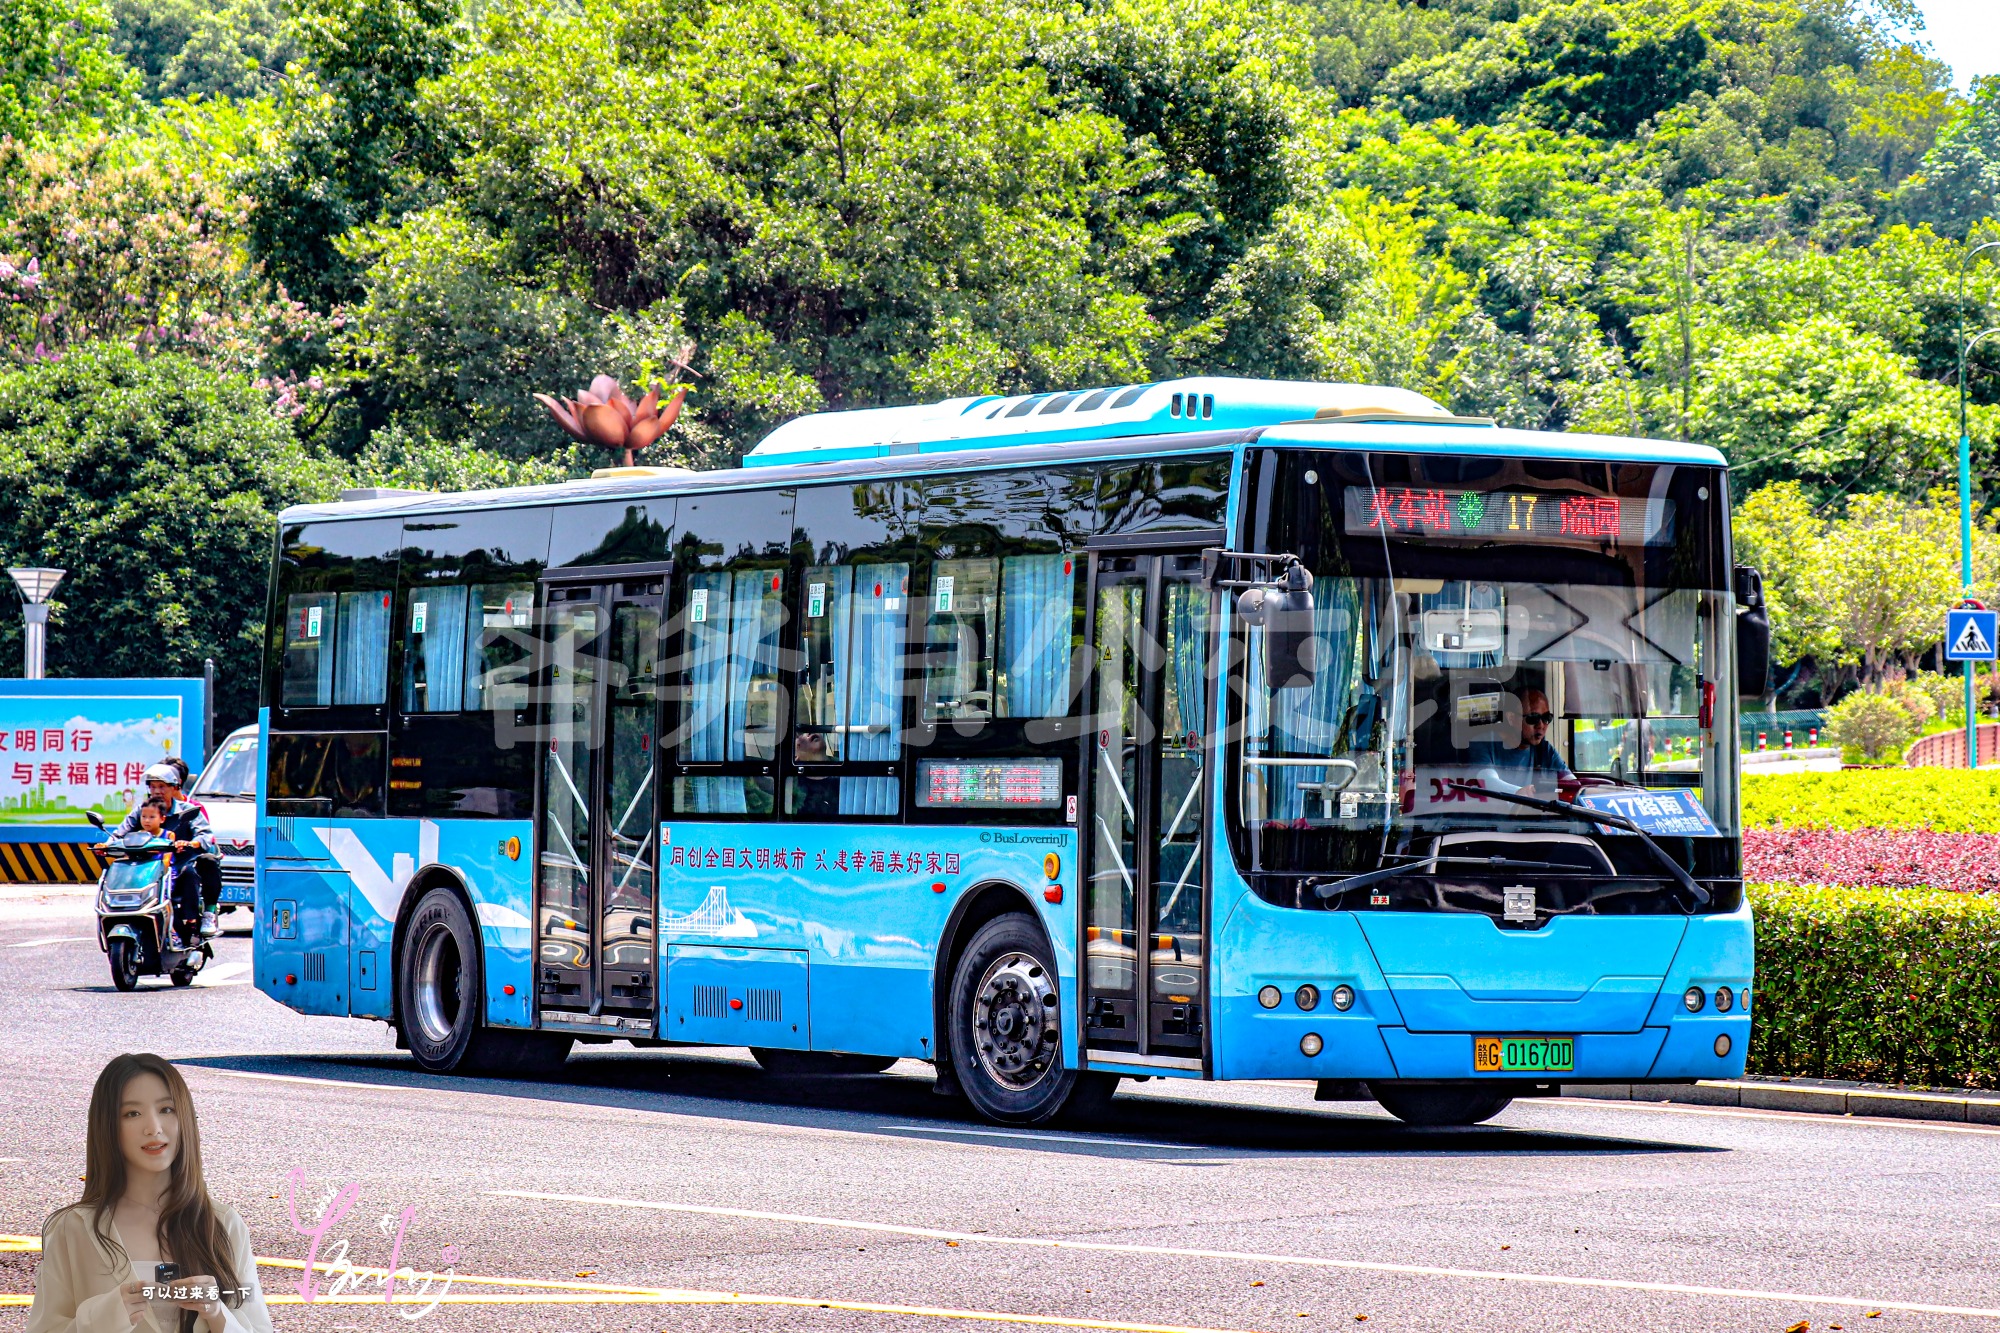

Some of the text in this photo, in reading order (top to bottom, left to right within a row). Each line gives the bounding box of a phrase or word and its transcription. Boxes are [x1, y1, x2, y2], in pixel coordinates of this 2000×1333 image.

[1369, 487, 1620, 536] 火车站 17 流园
[11, 762, 146, 786] 与幸福相伴
[1607, 795, 1685, 816] 17路南
[670, 846, 806, 870] 同创全国文明城市
[1372, 896, 1388, 904] 开关
